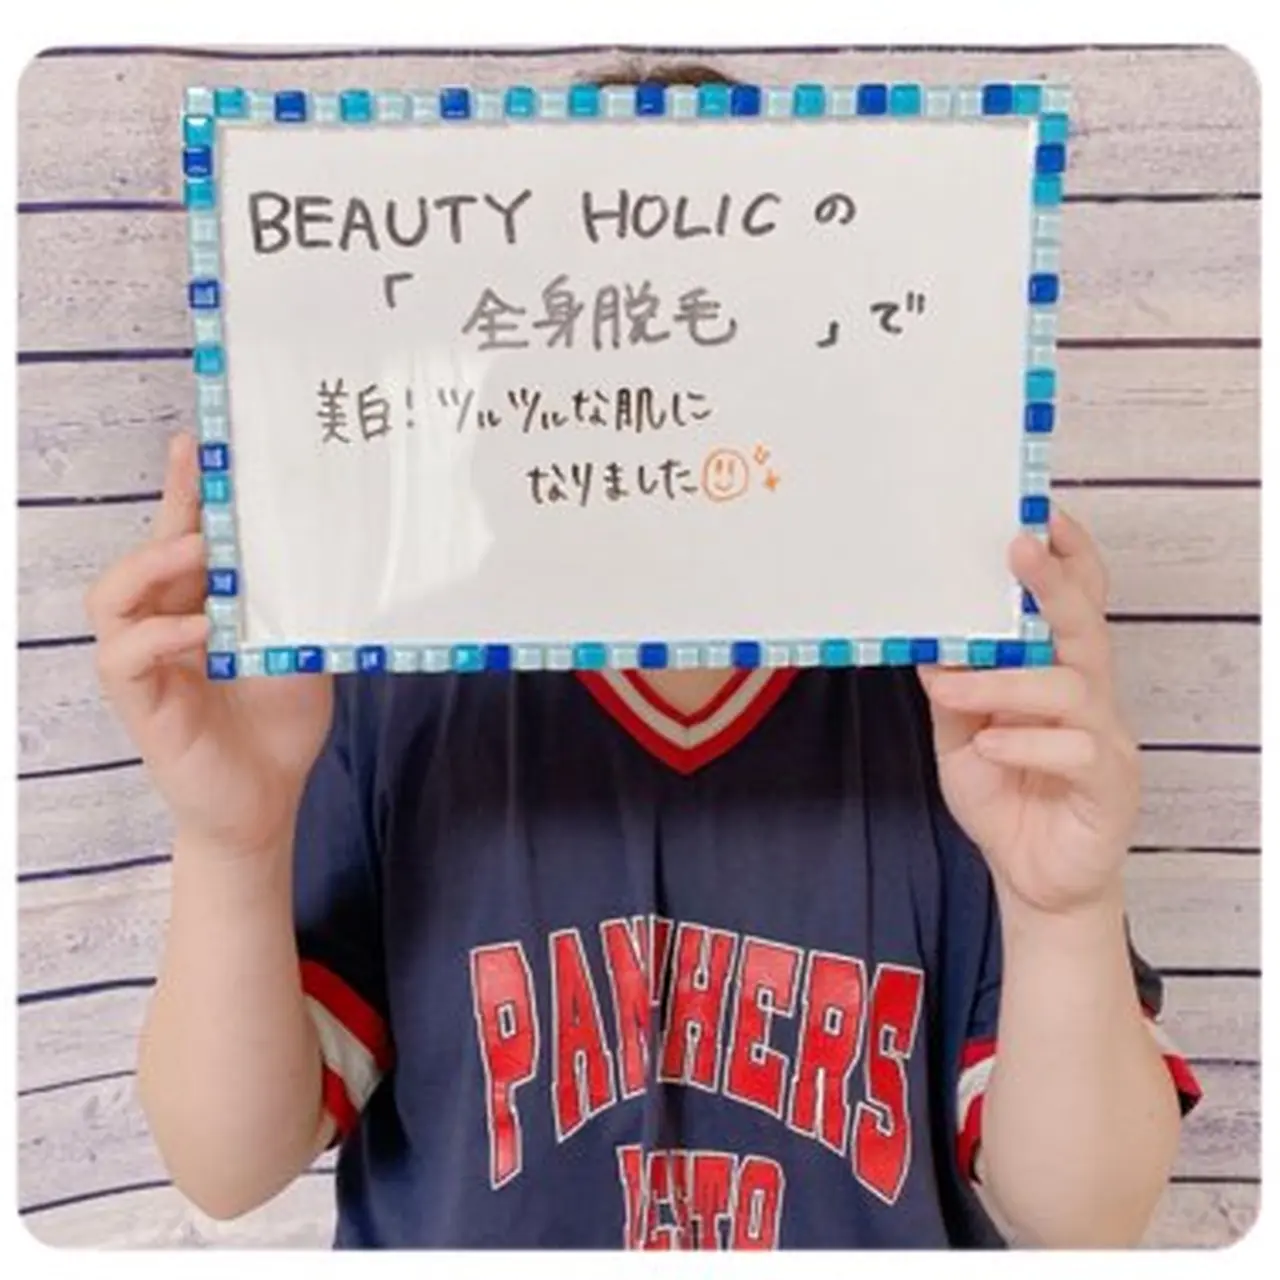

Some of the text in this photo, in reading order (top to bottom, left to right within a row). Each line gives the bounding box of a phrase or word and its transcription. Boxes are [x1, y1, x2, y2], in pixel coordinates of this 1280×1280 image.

[248, 189, 532, 255] BEAUTY
[582, 189, 780, 244] HOLIC
[528, 459, 697, 507] なりました
